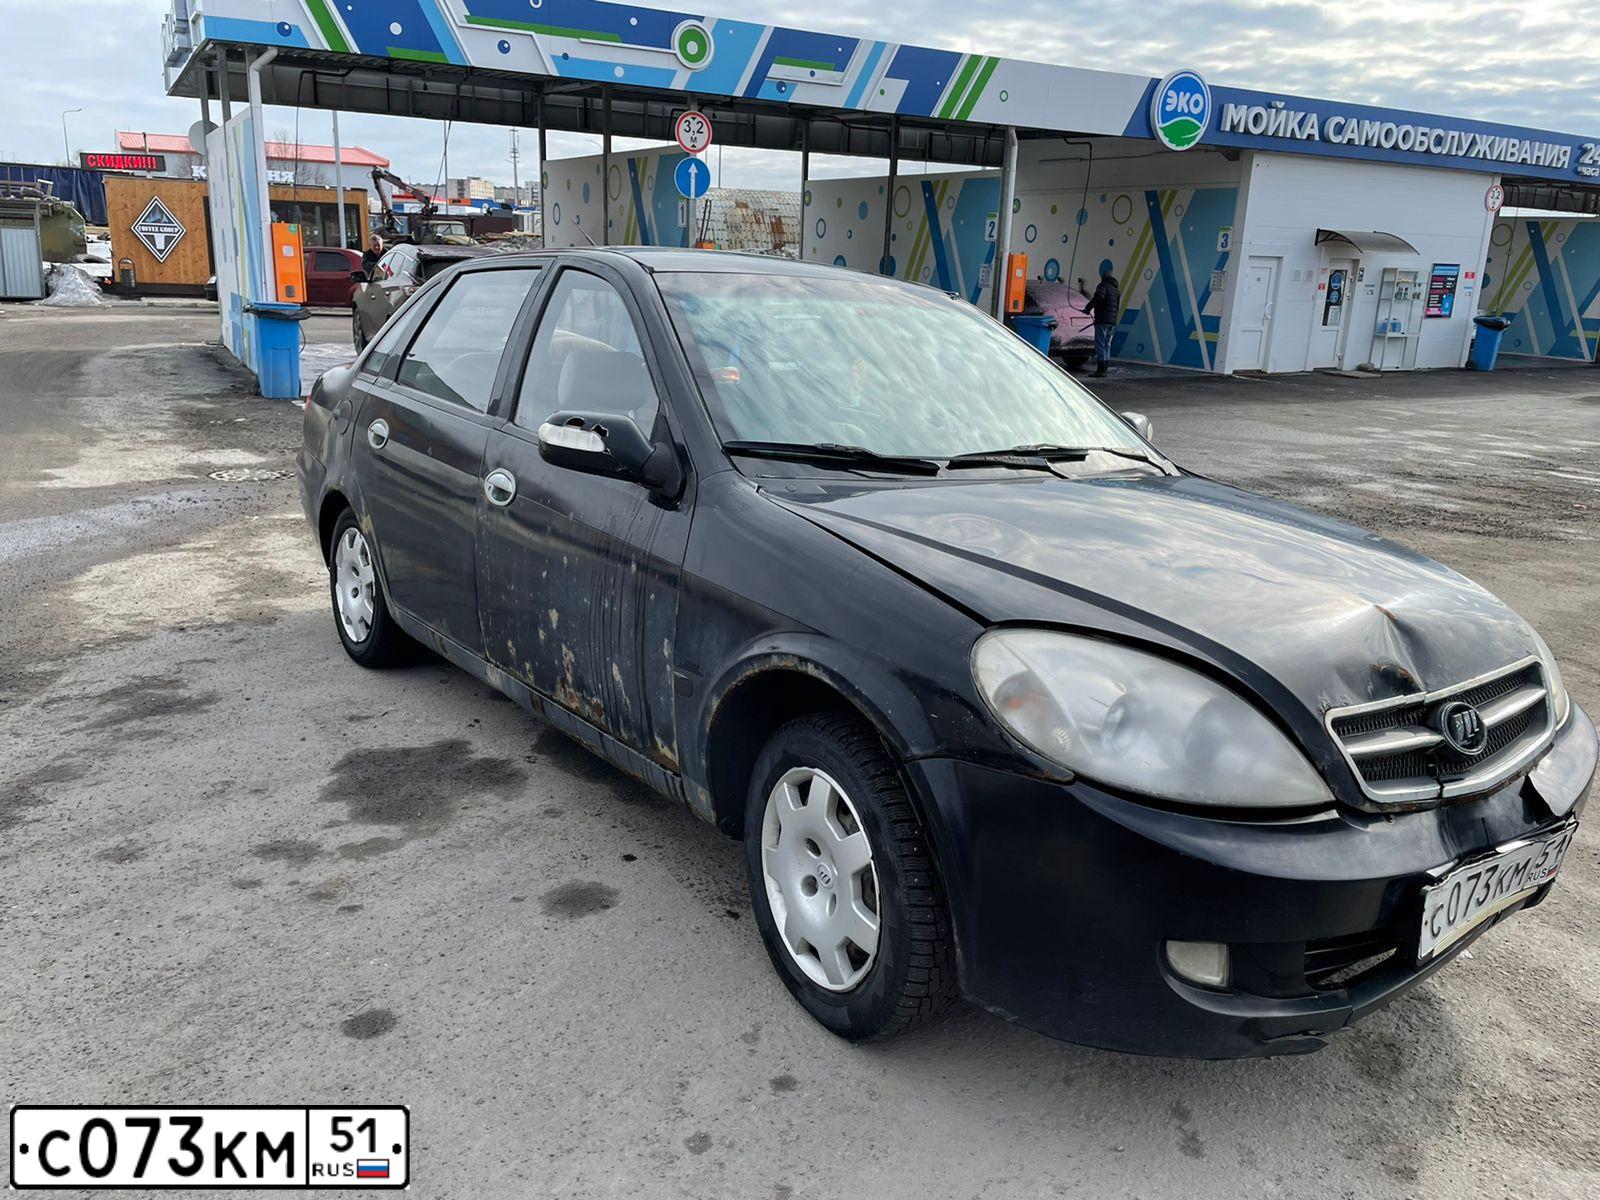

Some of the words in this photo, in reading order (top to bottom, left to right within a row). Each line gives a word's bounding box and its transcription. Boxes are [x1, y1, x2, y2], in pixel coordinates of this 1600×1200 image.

[1165, 89, 1204, 115] ЭКО
[683, 120, 704, 136] 3,2
[1220, 101, 1320, 142] МОЙКА
[1324, 116, 1572, 169] САМООБСЛУЖИВАНИЯ
[988, 221, 996, 239] 2
[1220, 233, 1230, 249] 3
[1528, 867, 1548, 882] RUS
